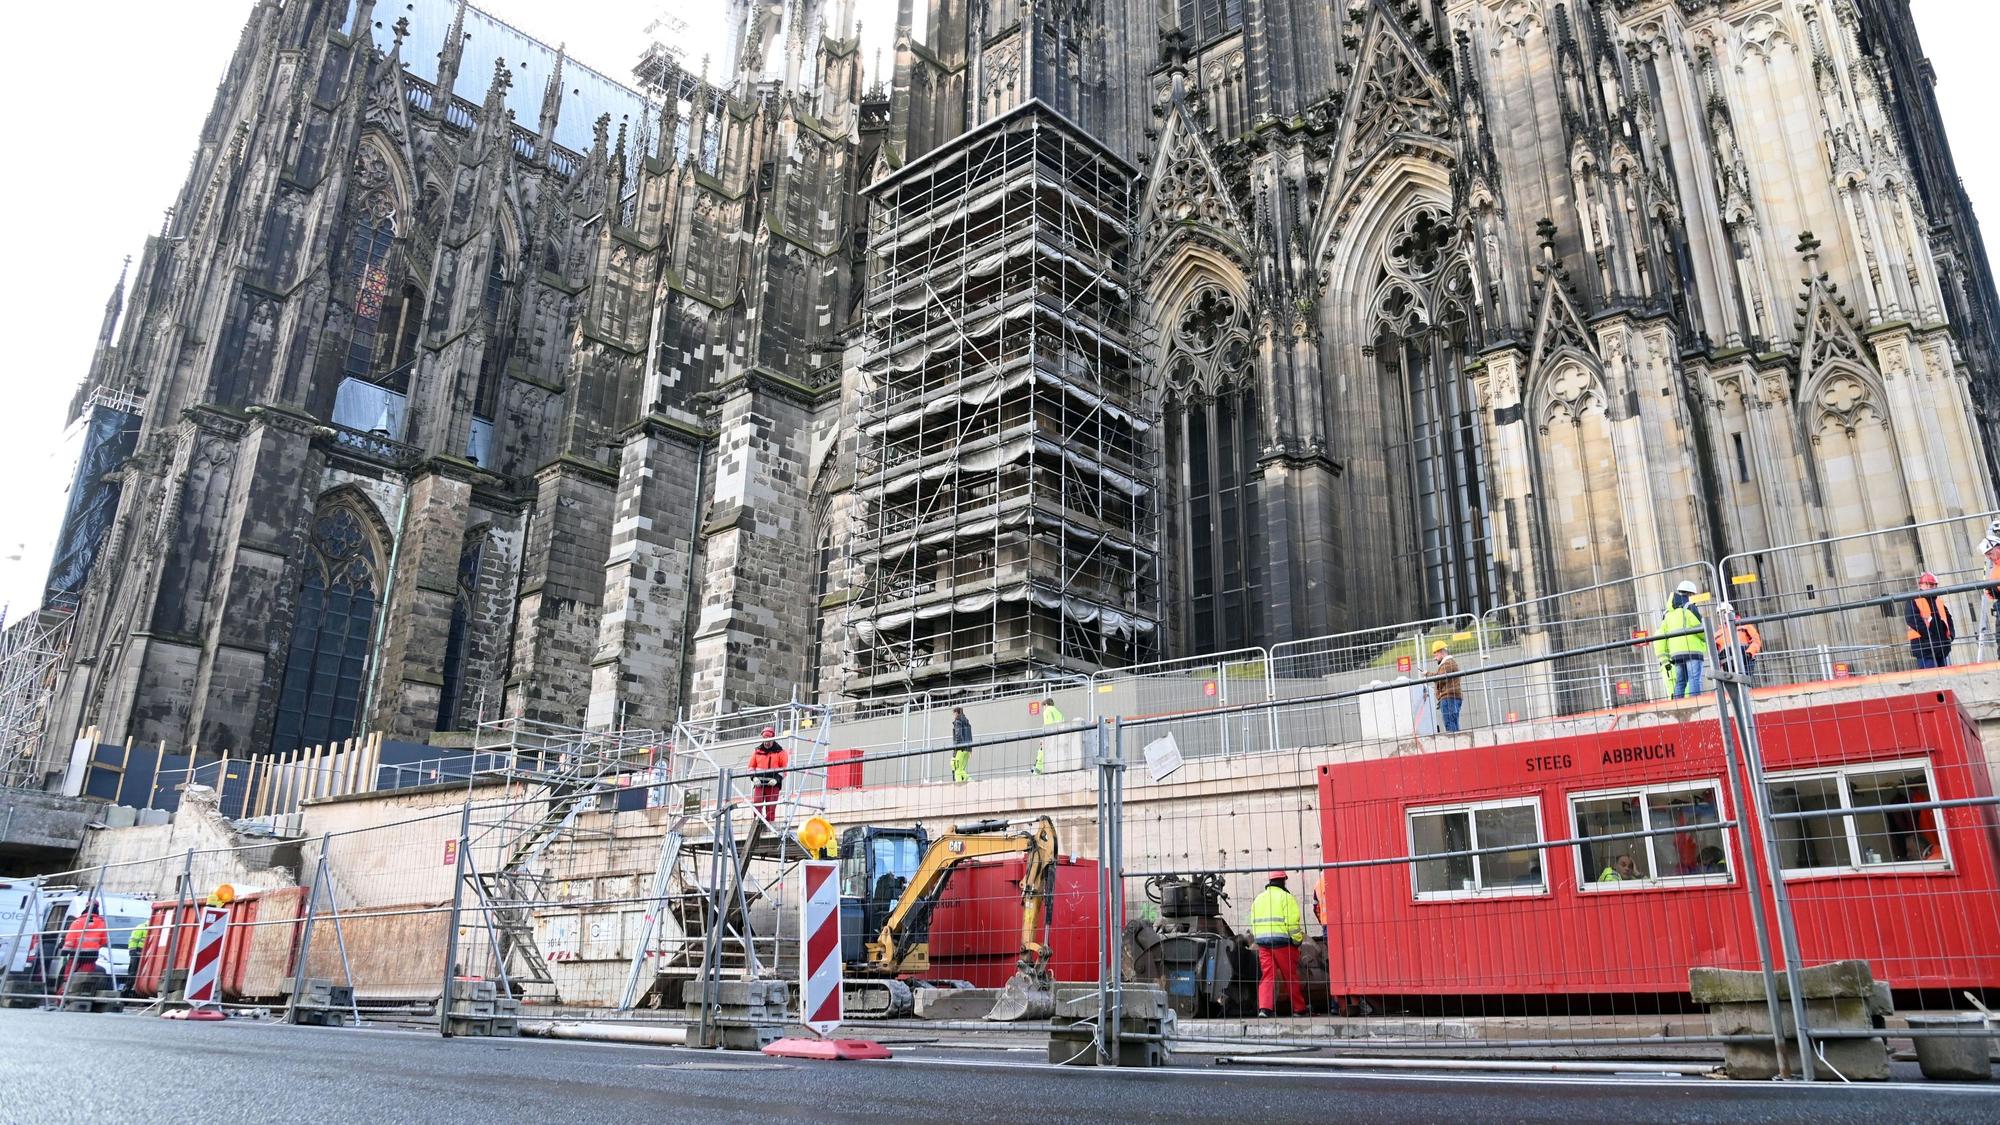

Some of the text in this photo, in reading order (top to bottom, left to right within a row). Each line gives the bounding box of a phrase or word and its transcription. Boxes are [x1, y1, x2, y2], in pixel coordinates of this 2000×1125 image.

[1526, 743, 1675, 772] STEEG ABBRUCH
[949, 841, 962, 852] CAT
